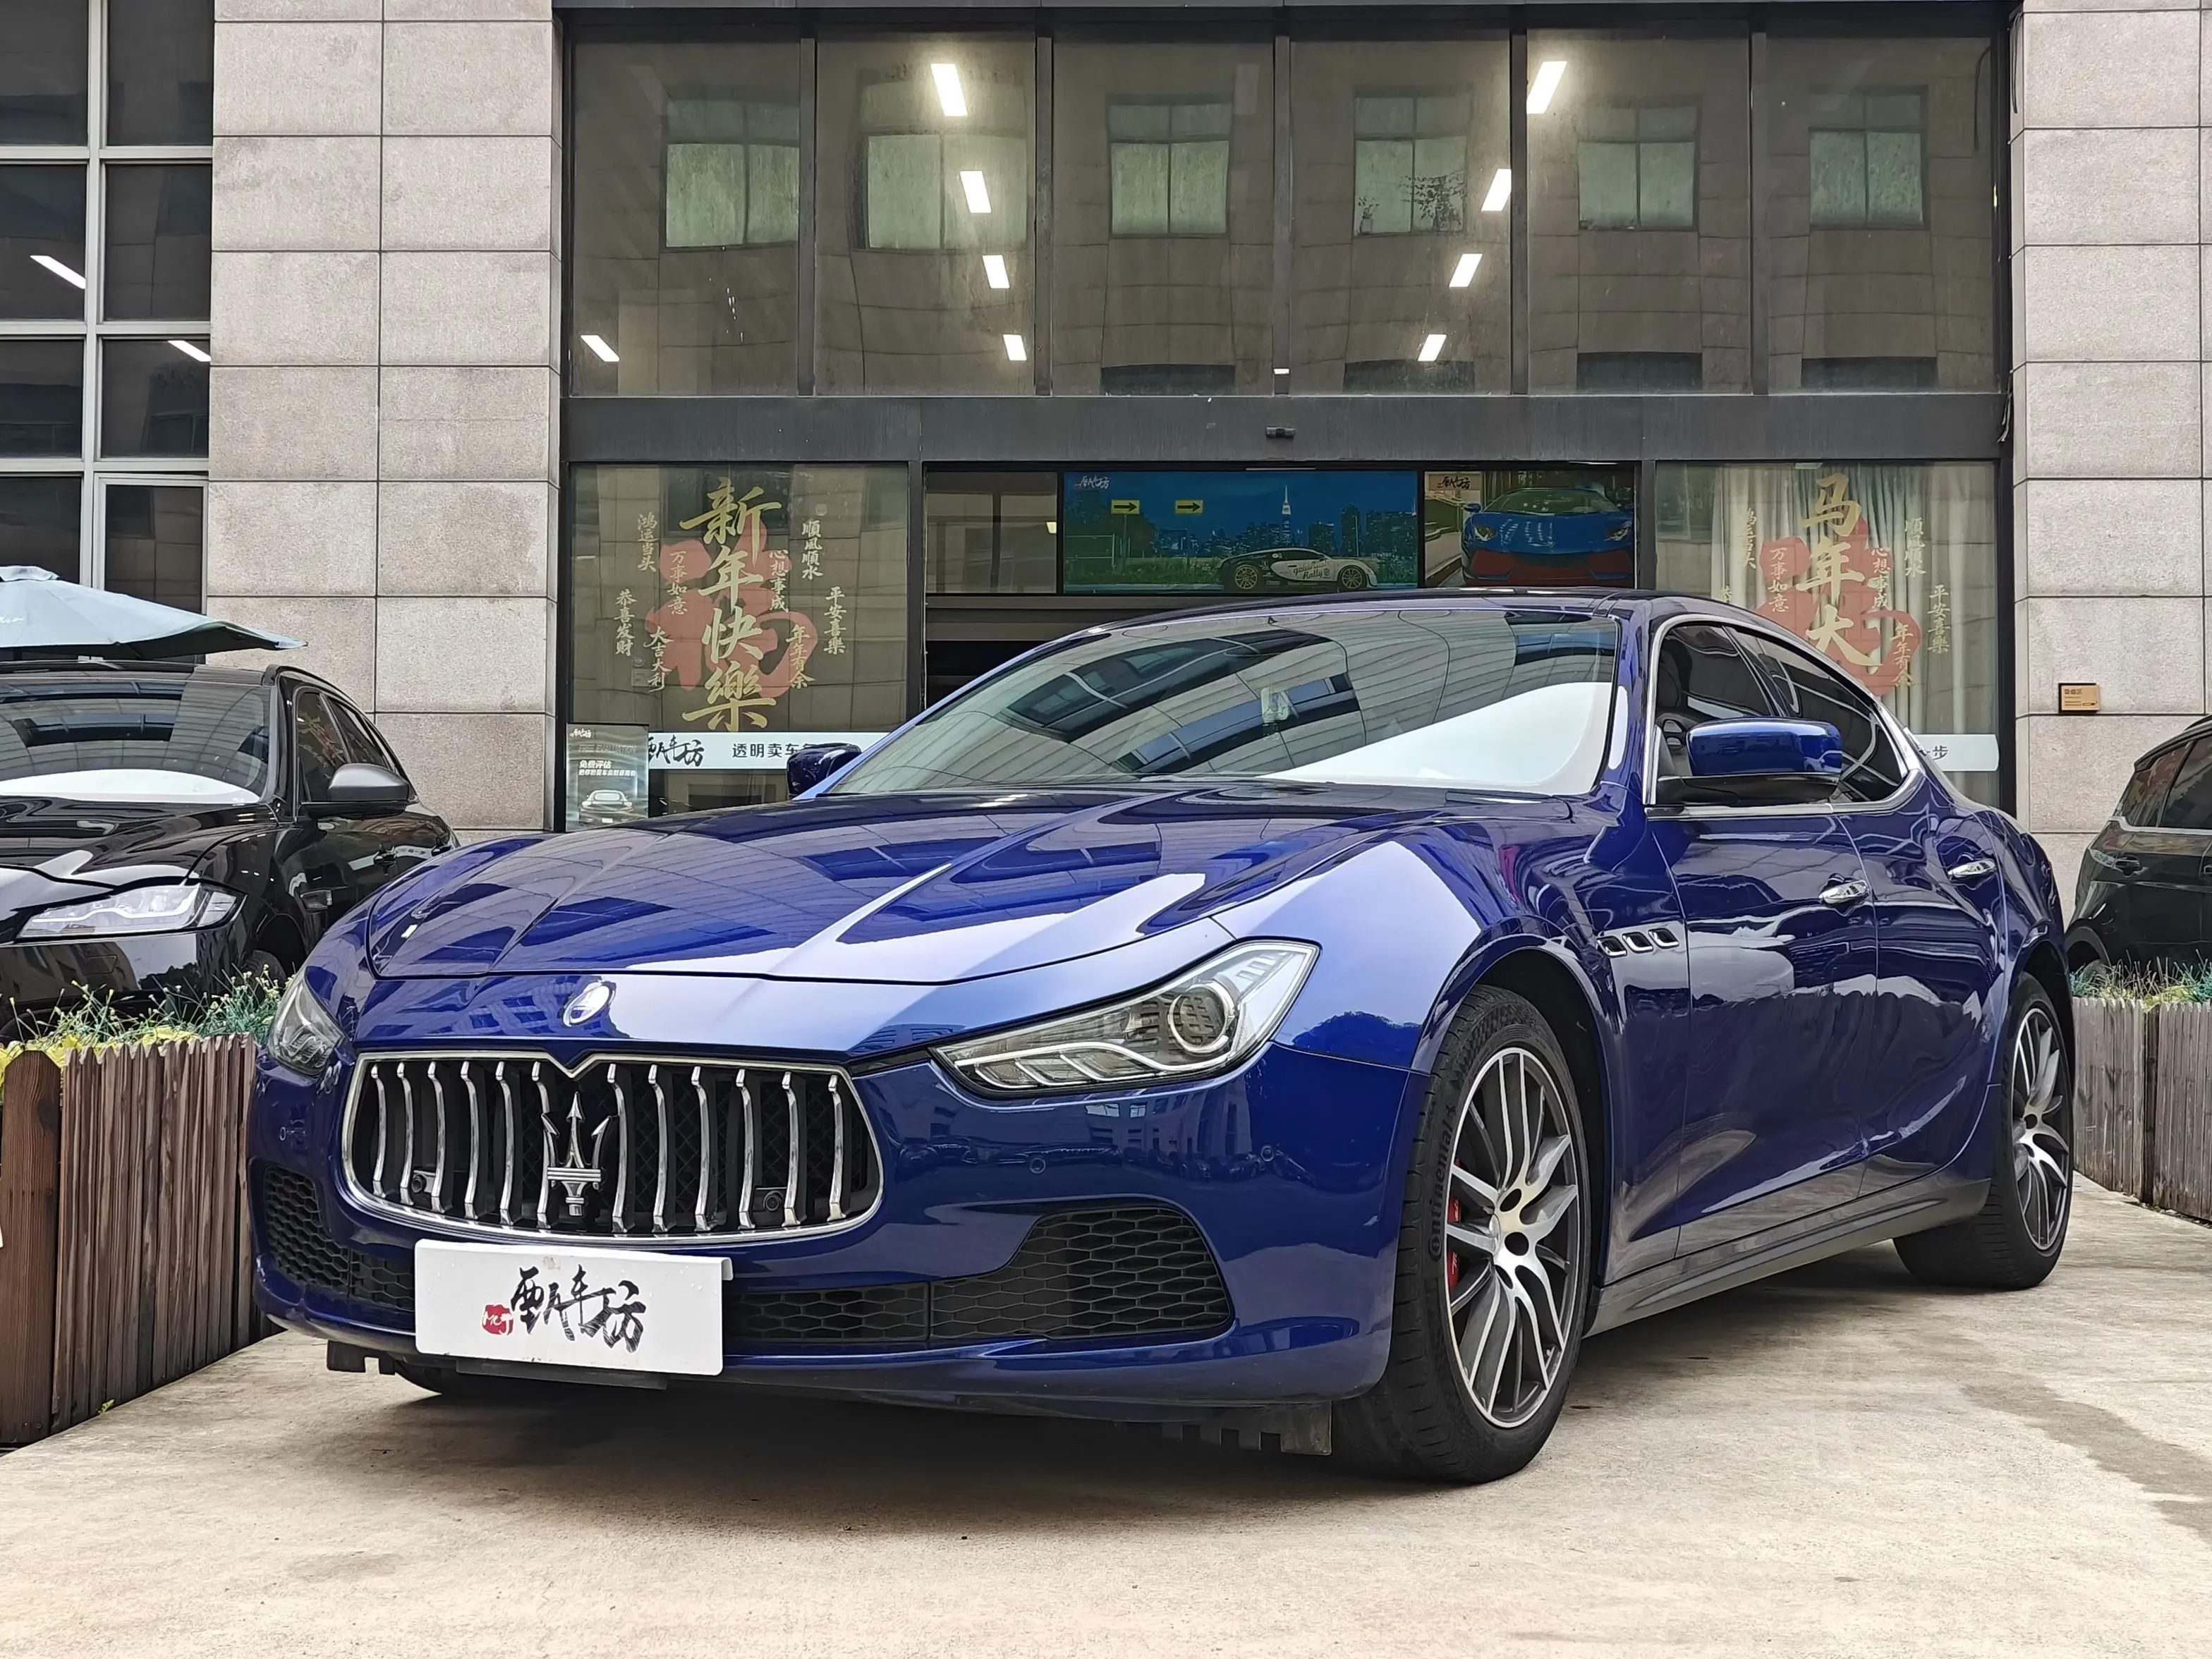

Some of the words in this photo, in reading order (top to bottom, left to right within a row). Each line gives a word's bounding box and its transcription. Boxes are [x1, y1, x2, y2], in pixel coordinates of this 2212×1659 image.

[638, 512, 659, 572] 鸿运当头
[667, 551, 688, 615] 万事如意
[769, 549, 789, 613] 心想事成
[1768, 547, 1789, 612] 万事如意
[1871, 547, 1892, 611] 心想事成
[614, 588, 637, 656] 恭喜发财
[643, 626, 674, 693] 大吉大利
[785, 624, 815, 689] 年年有余
[1890, 622, 1914, 687] 年年有余
[579, 760, 612, 769] 免费评估
[732, 743, 813, 758] 透明卖车
[1926, 746, 1948, 760] 步
